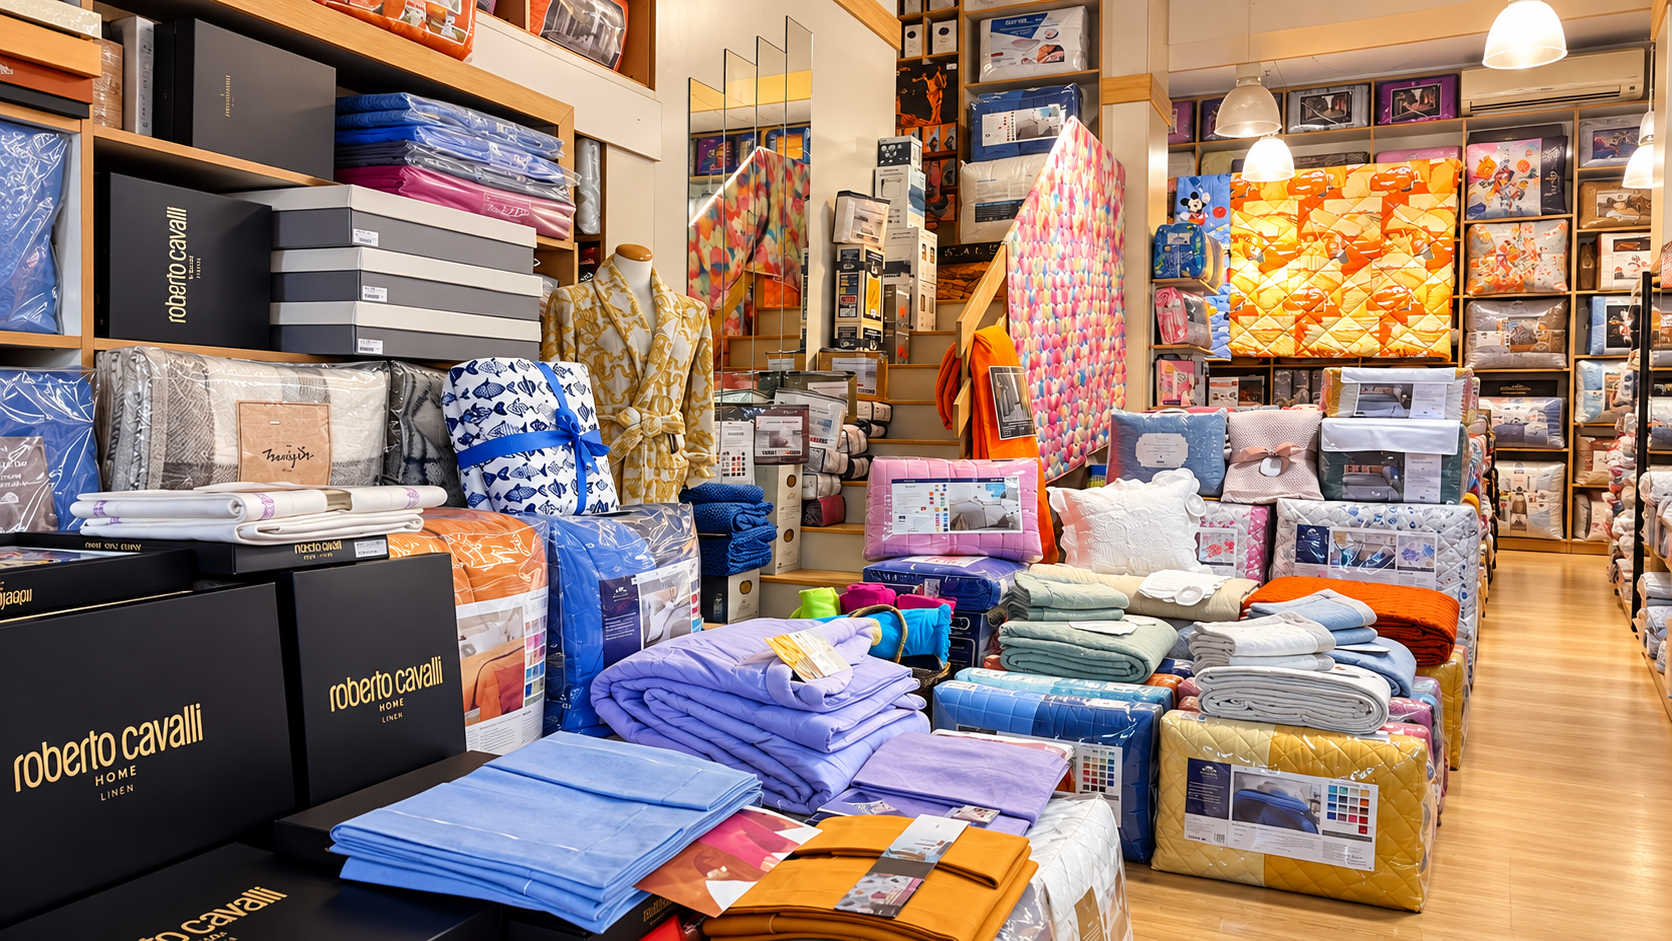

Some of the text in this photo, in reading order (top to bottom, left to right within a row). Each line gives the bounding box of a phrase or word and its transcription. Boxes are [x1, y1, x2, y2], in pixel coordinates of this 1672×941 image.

[165, 206, 187, 324] roberto cavalli
[329, 655, 443, 712] roberto cavalli
[379, 698, 404, 712] HOME
[13, 703, 204, 793] roberto cavalli
[95, 765, 137, 786] HOME
[100, 784, 134, 801] LINEN
[181, 886, 288, 934] cavalli
